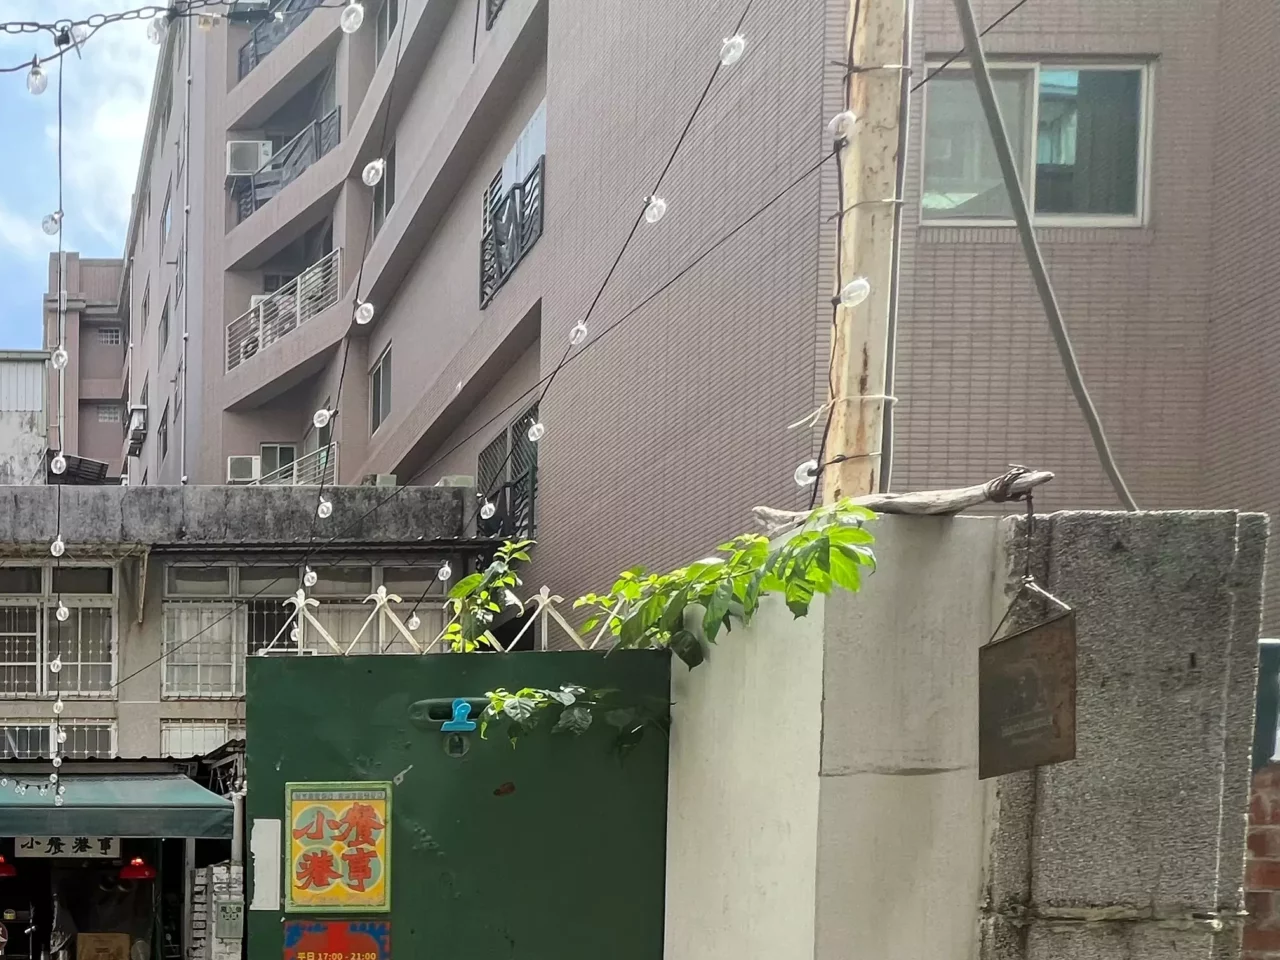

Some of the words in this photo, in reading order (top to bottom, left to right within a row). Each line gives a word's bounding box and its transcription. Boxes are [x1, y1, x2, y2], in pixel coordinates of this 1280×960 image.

[297, 952, 315, 960] 平日
[317, 952, 343, 960] 17:00
[350, 952, 376, 960] 21:00
